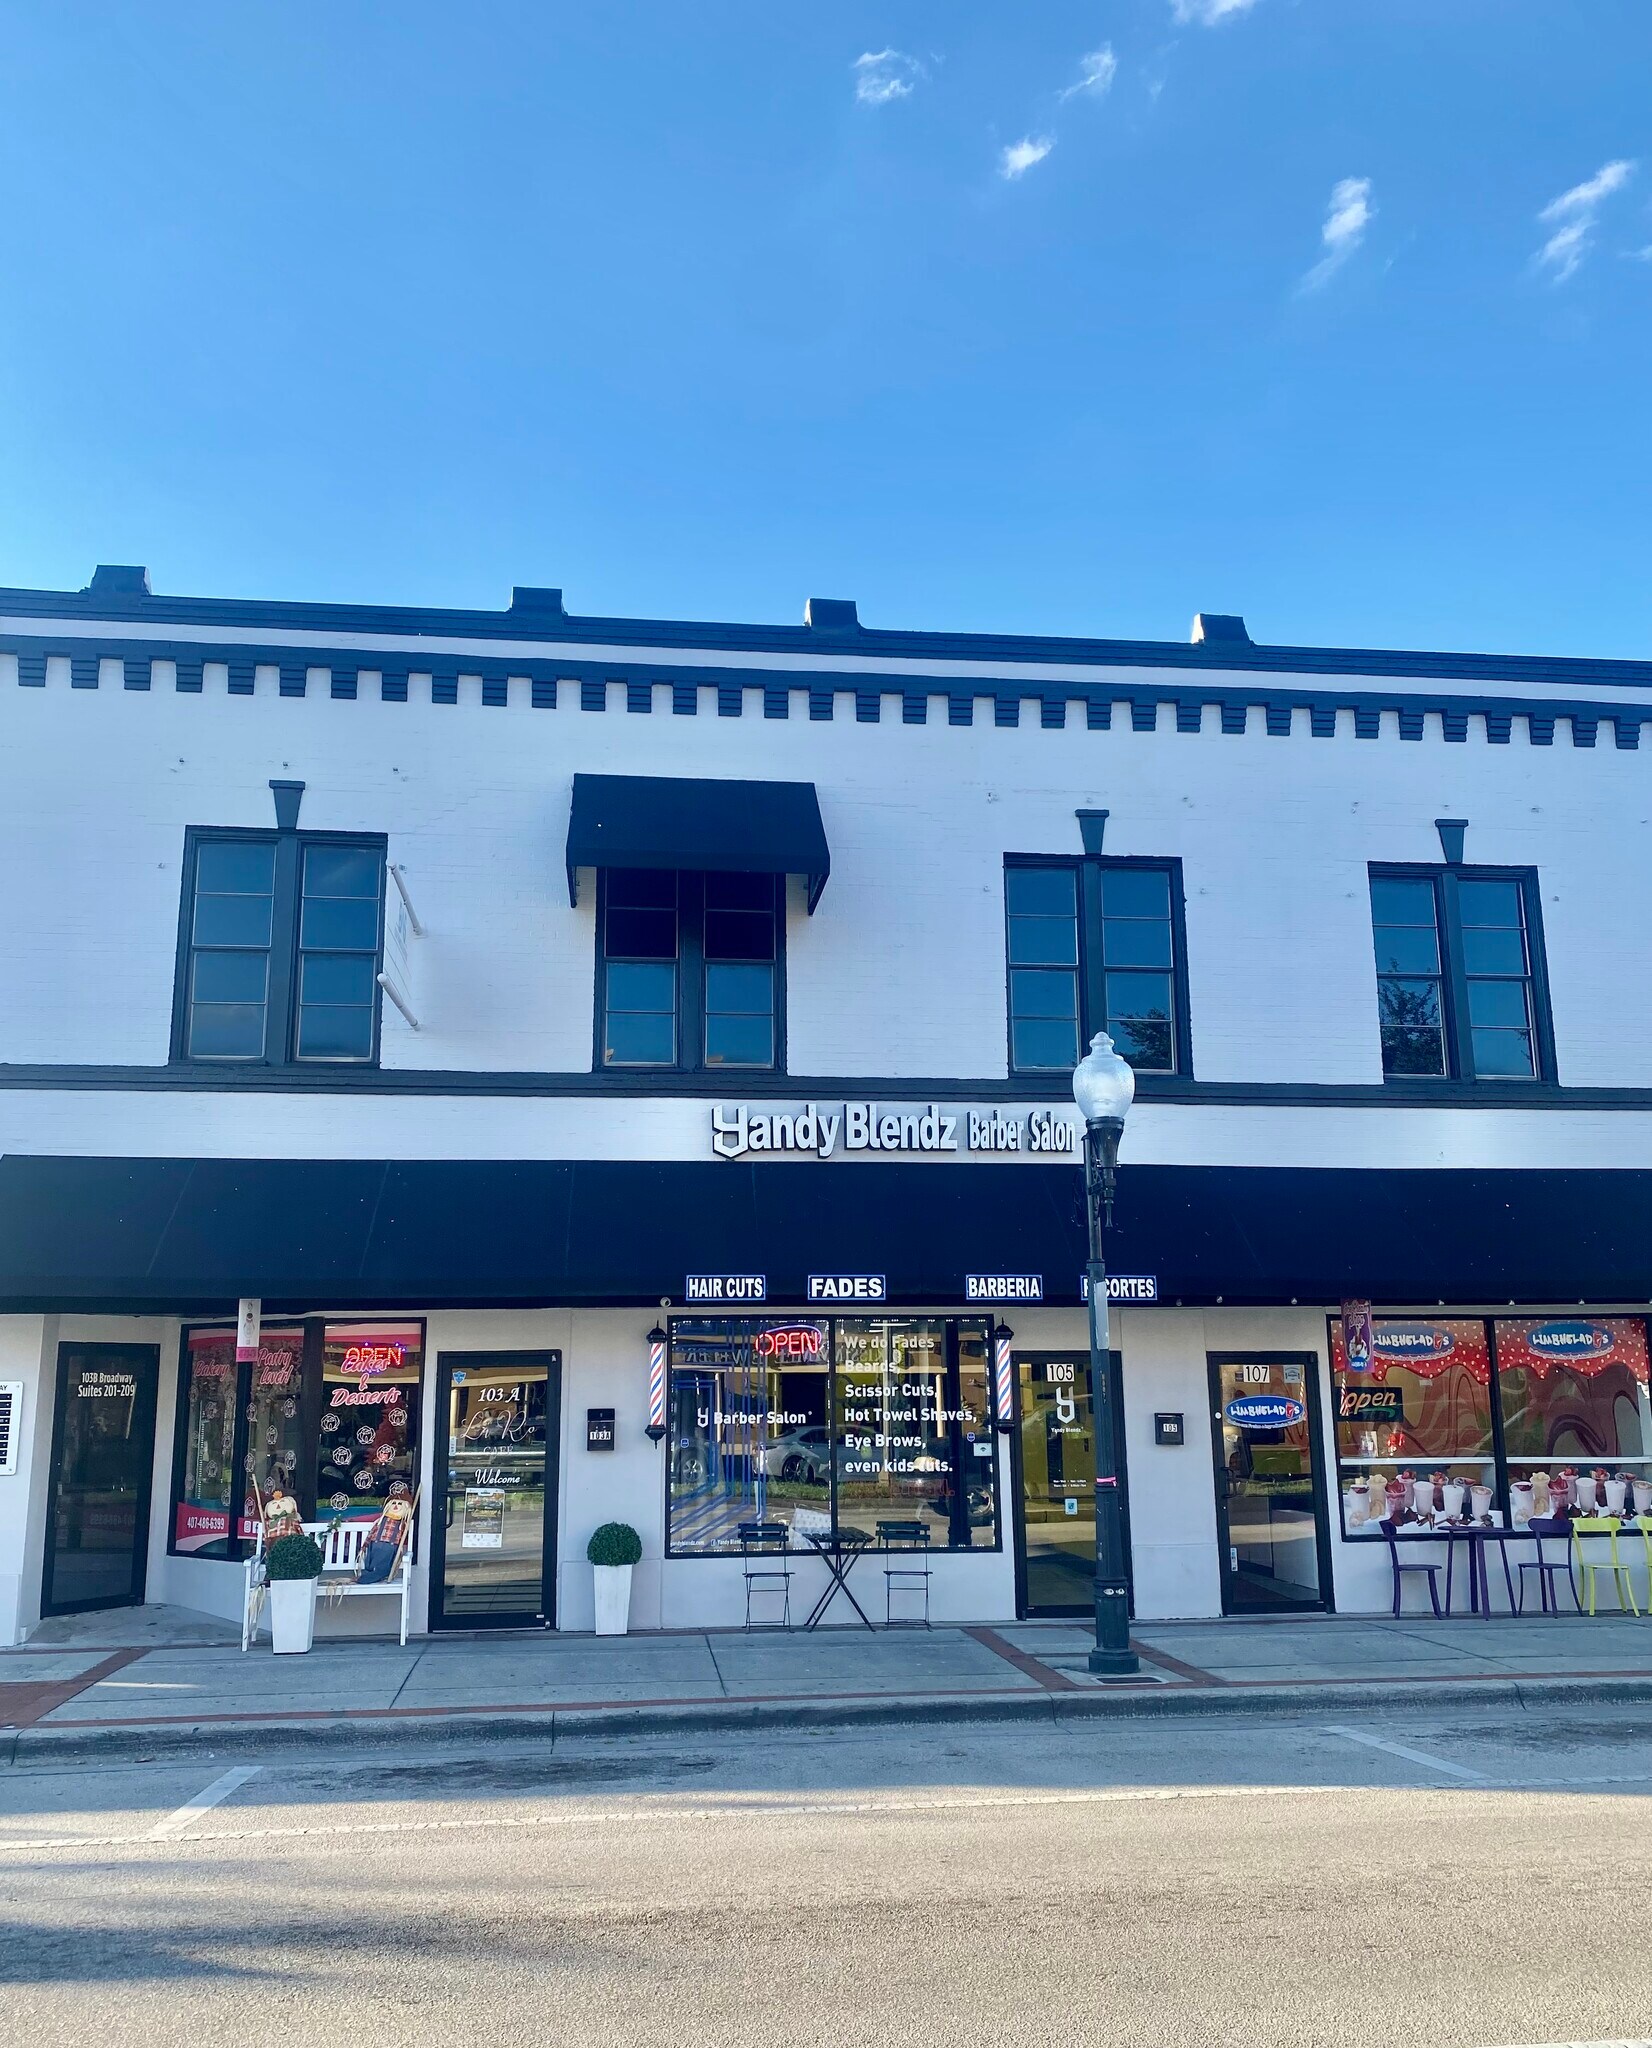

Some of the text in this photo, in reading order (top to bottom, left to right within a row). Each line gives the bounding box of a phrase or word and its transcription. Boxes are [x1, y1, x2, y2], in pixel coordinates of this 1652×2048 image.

[844, 1103, 958, 1152] Blendz
[968, 1110, 1024, 1151] Barber
[1028, 1110, 1076, 1152] Salon
[688, 1278, 763, 1298] HAIR CUTS
[811, 1277, 883, 1298] FADES
[968, 1277, 1041, 1298] BARBERIA
[1084, 1278, 1154, 1298] CORTES
[756, 1332, 818, 1356] OPEN
[844, 1336, 934, 1348] We do Fades
[341, 1354, 390, 1373] Cakes
[345, 1347, 402, 1366] OPEN
[846, 1360, 900, 1374] Beards,
[1049, 1365, 1073, 1381] 105
[1246, 1366, 1269, 1382] 107
[82, 1372, 133, 1385] 103B Broadway
[78, 1385, 135, 1397] Suites 201-209
[330, 1387, 402, 1406] Desserts
[478, 1386, 520, 1403] 103 A
[845, 1384, 938, 1398] Scissor Cuts,
[714, 1411, 763, 1424] Barber
[767, 1411, 806, 1424] Salon
[845, 1408, 977, 1423] Hot Towel Shaves,
[591, 1431, 611, 1440] 103A
[1164, 1424, 1177, 1432] 105
[845, 1435, 927, 1451] Eye Brows,
[845, 1462, 880, 1472] even
[884, 1459, 914, 1472] kids
[475, 1468, 520, 1485] Welcome
[187, 1516, 225, 1530] 407-486-6399
